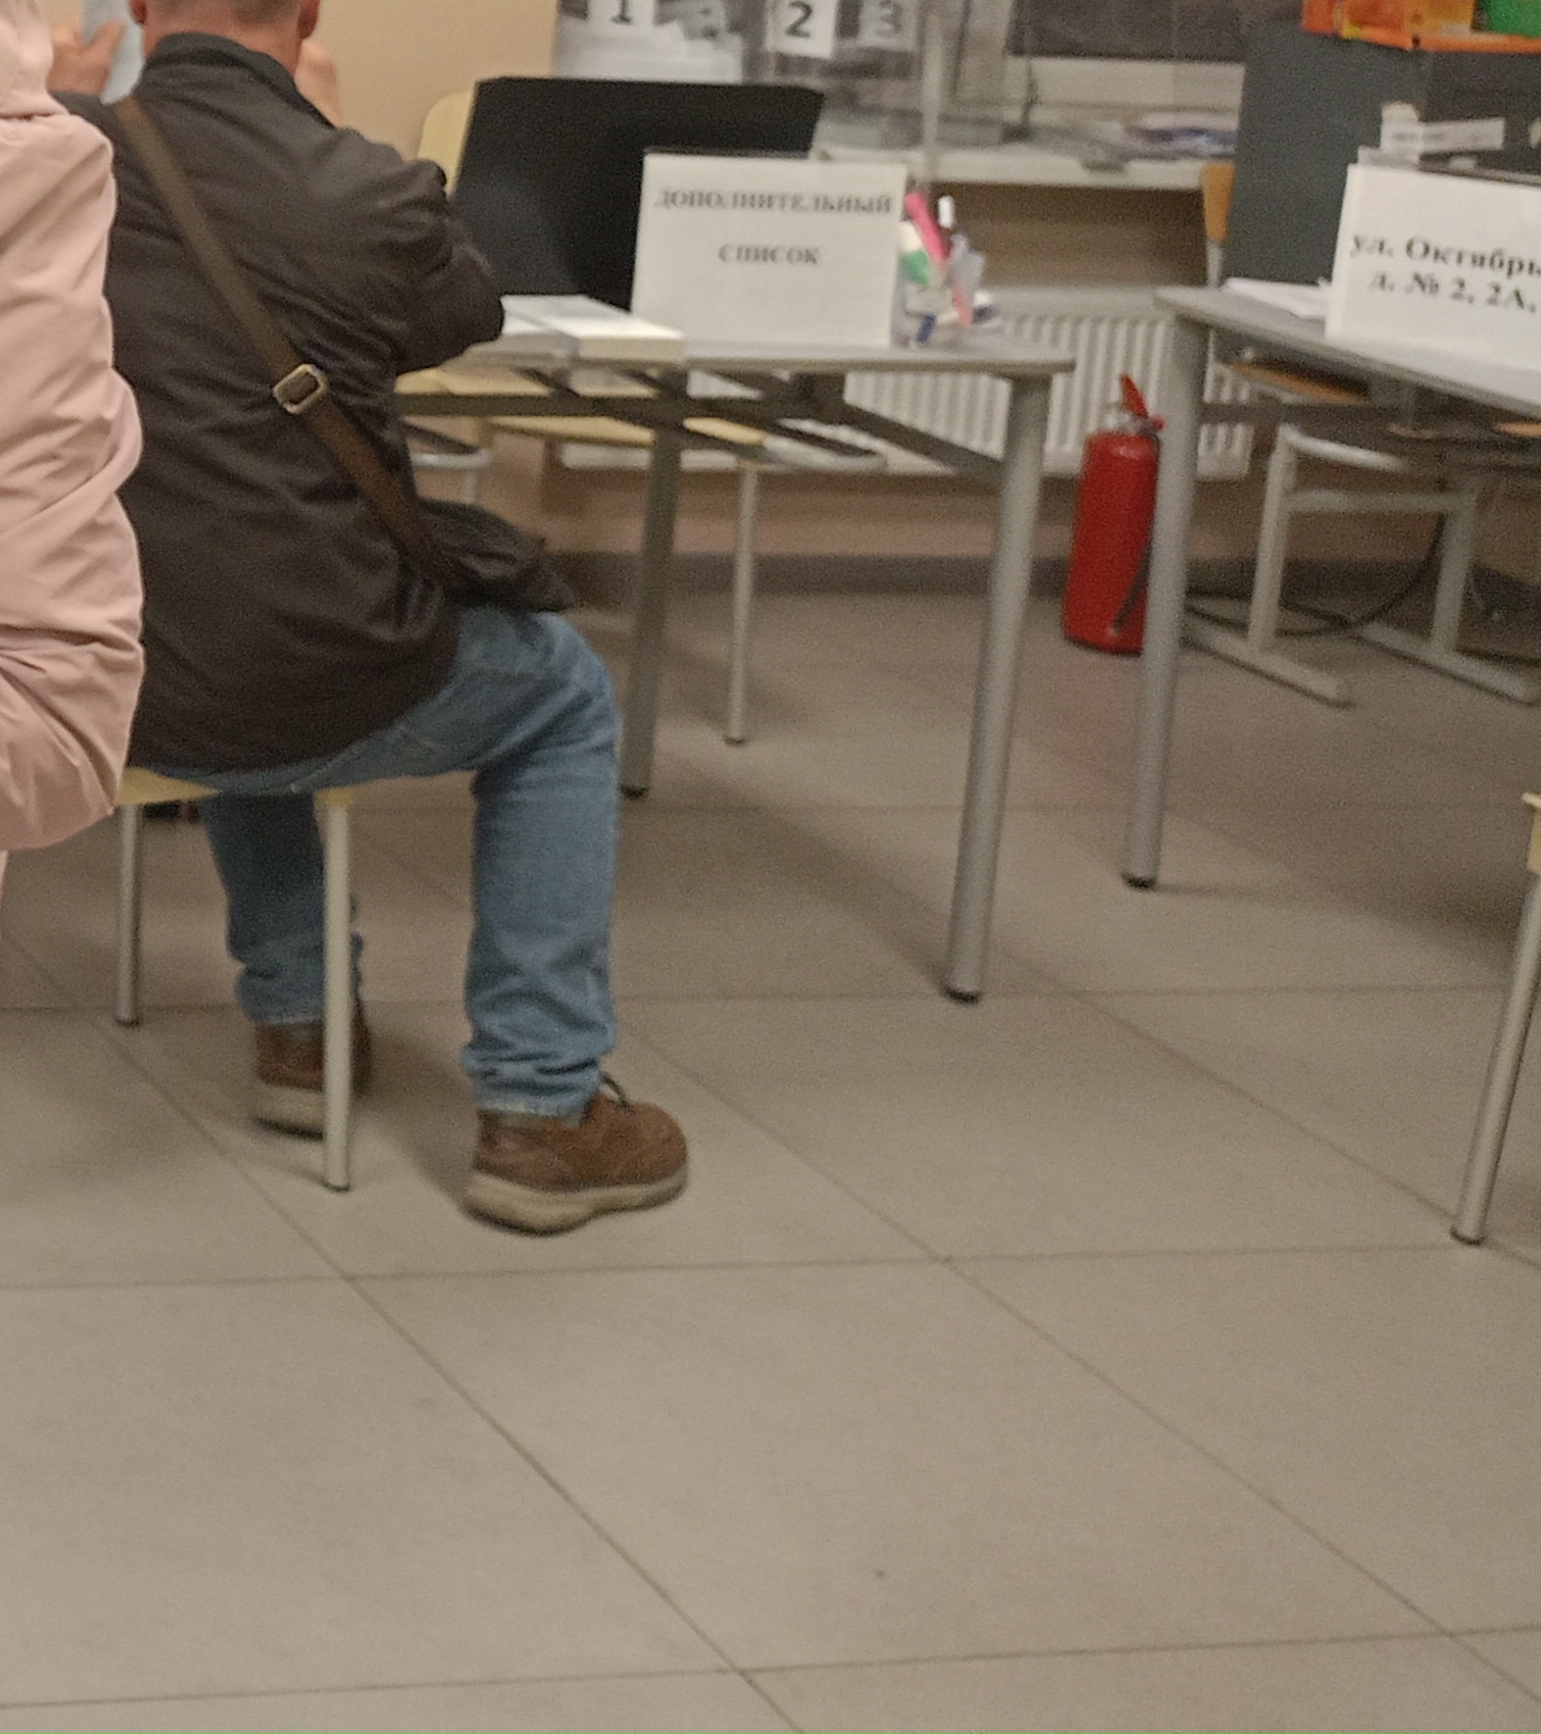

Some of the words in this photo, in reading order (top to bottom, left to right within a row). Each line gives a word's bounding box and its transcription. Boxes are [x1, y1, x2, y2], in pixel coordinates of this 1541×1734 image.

[784, 0, 813, 39] 2
[654, 188, 892, 215] ДОПОЛНИТЕЛЬНЫЙ
[717, 241, 820, 265] СПИСОК
[1350, 233, 1394, 259] ул.
